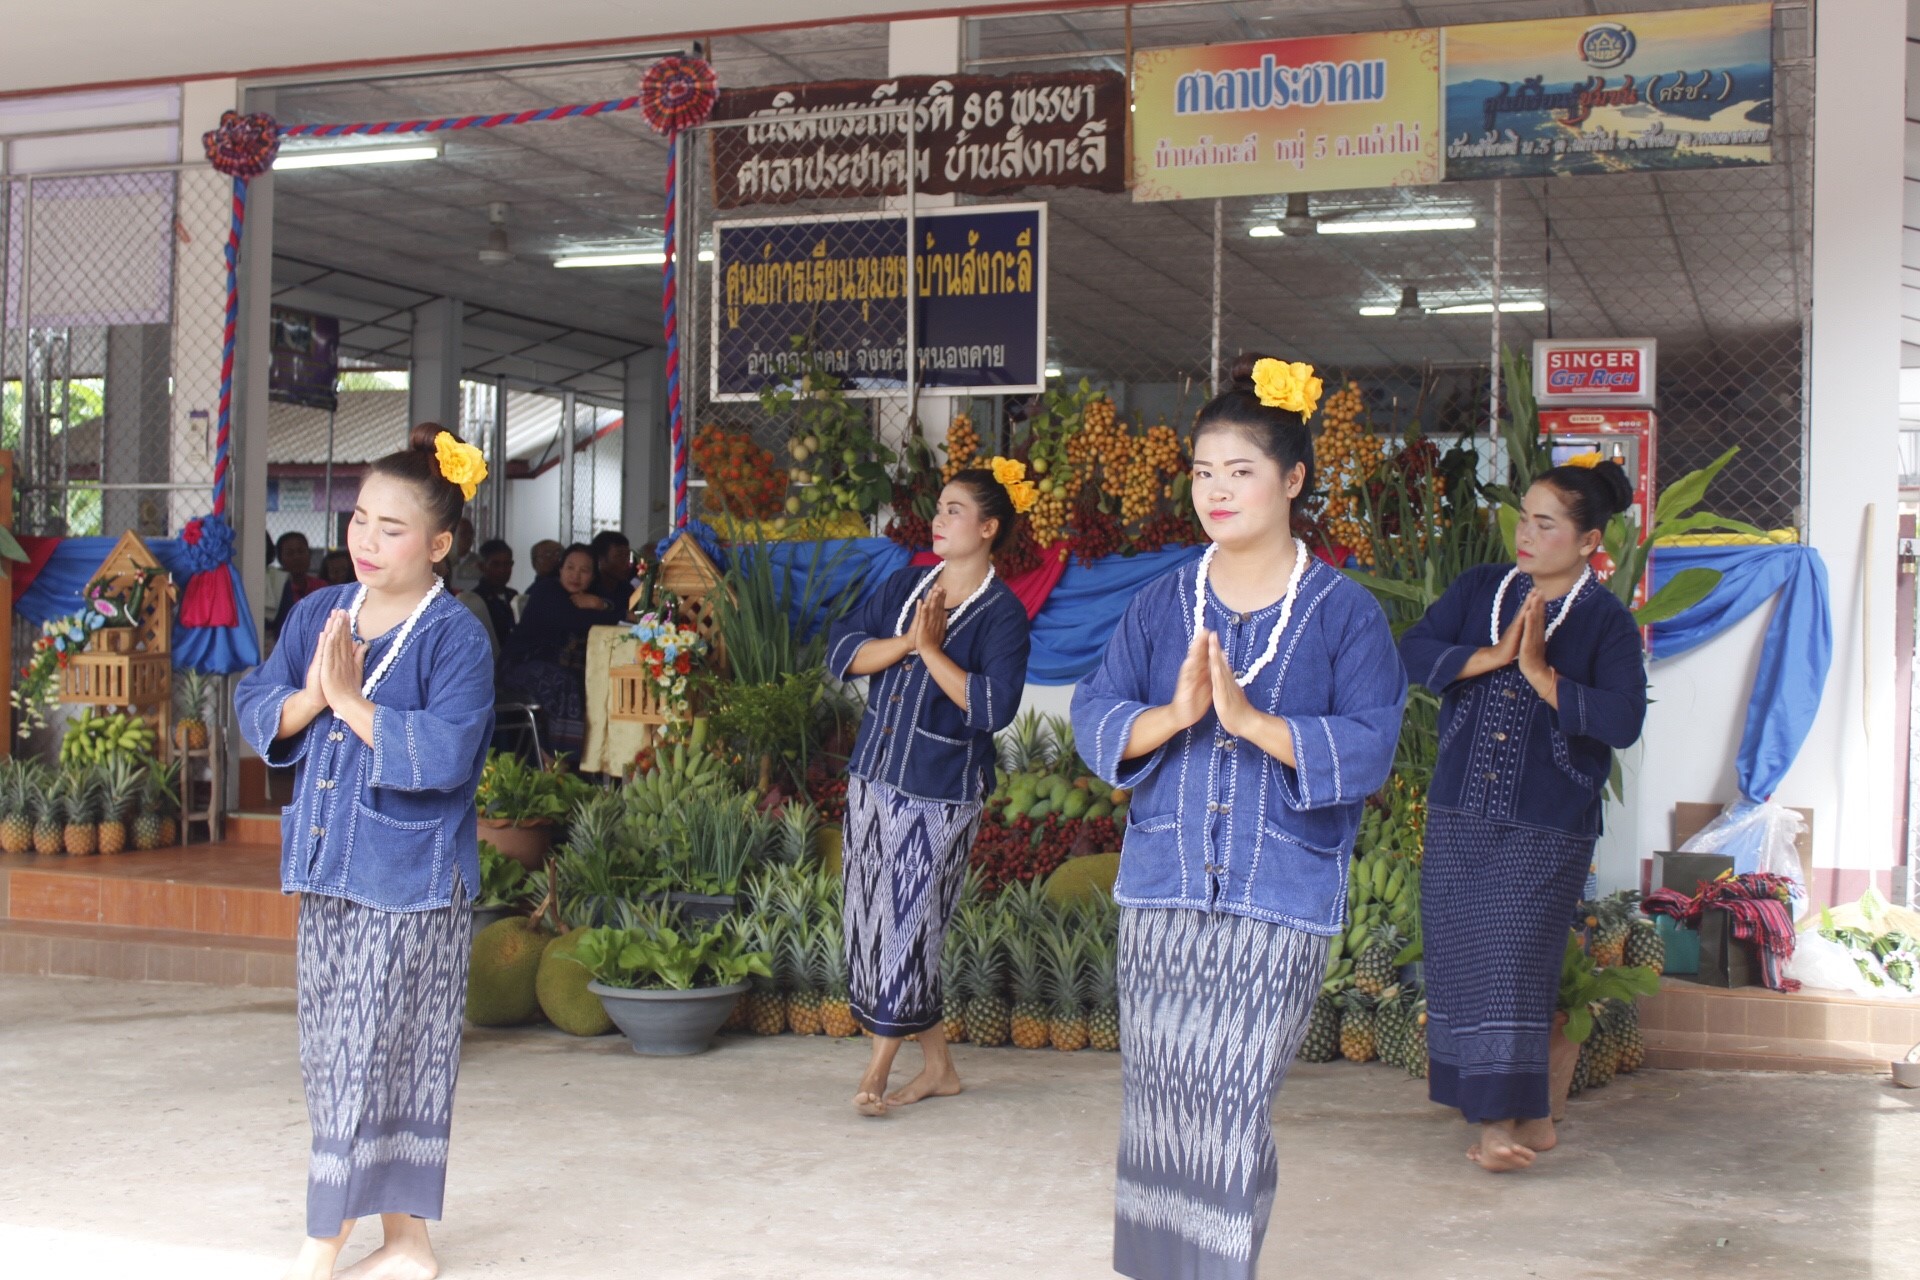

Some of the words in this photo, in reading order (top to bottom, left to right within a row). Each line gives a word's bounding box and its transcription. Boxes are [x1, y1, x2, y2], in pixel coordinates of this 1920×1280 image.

[1176, 55, 1386, 114] ศาลาประชาคม
[961, 91, 1005, 130] 86
[1010, 84, 1096, 126] พรรษา
[1314, 136, 1327, 158] 5
[737, 144, 930, 196] ศาลาประชาคม
[856, 337, 1005, 371] จังหวัหนองคาย
[1550, 352, 1635, 368] SINGER
